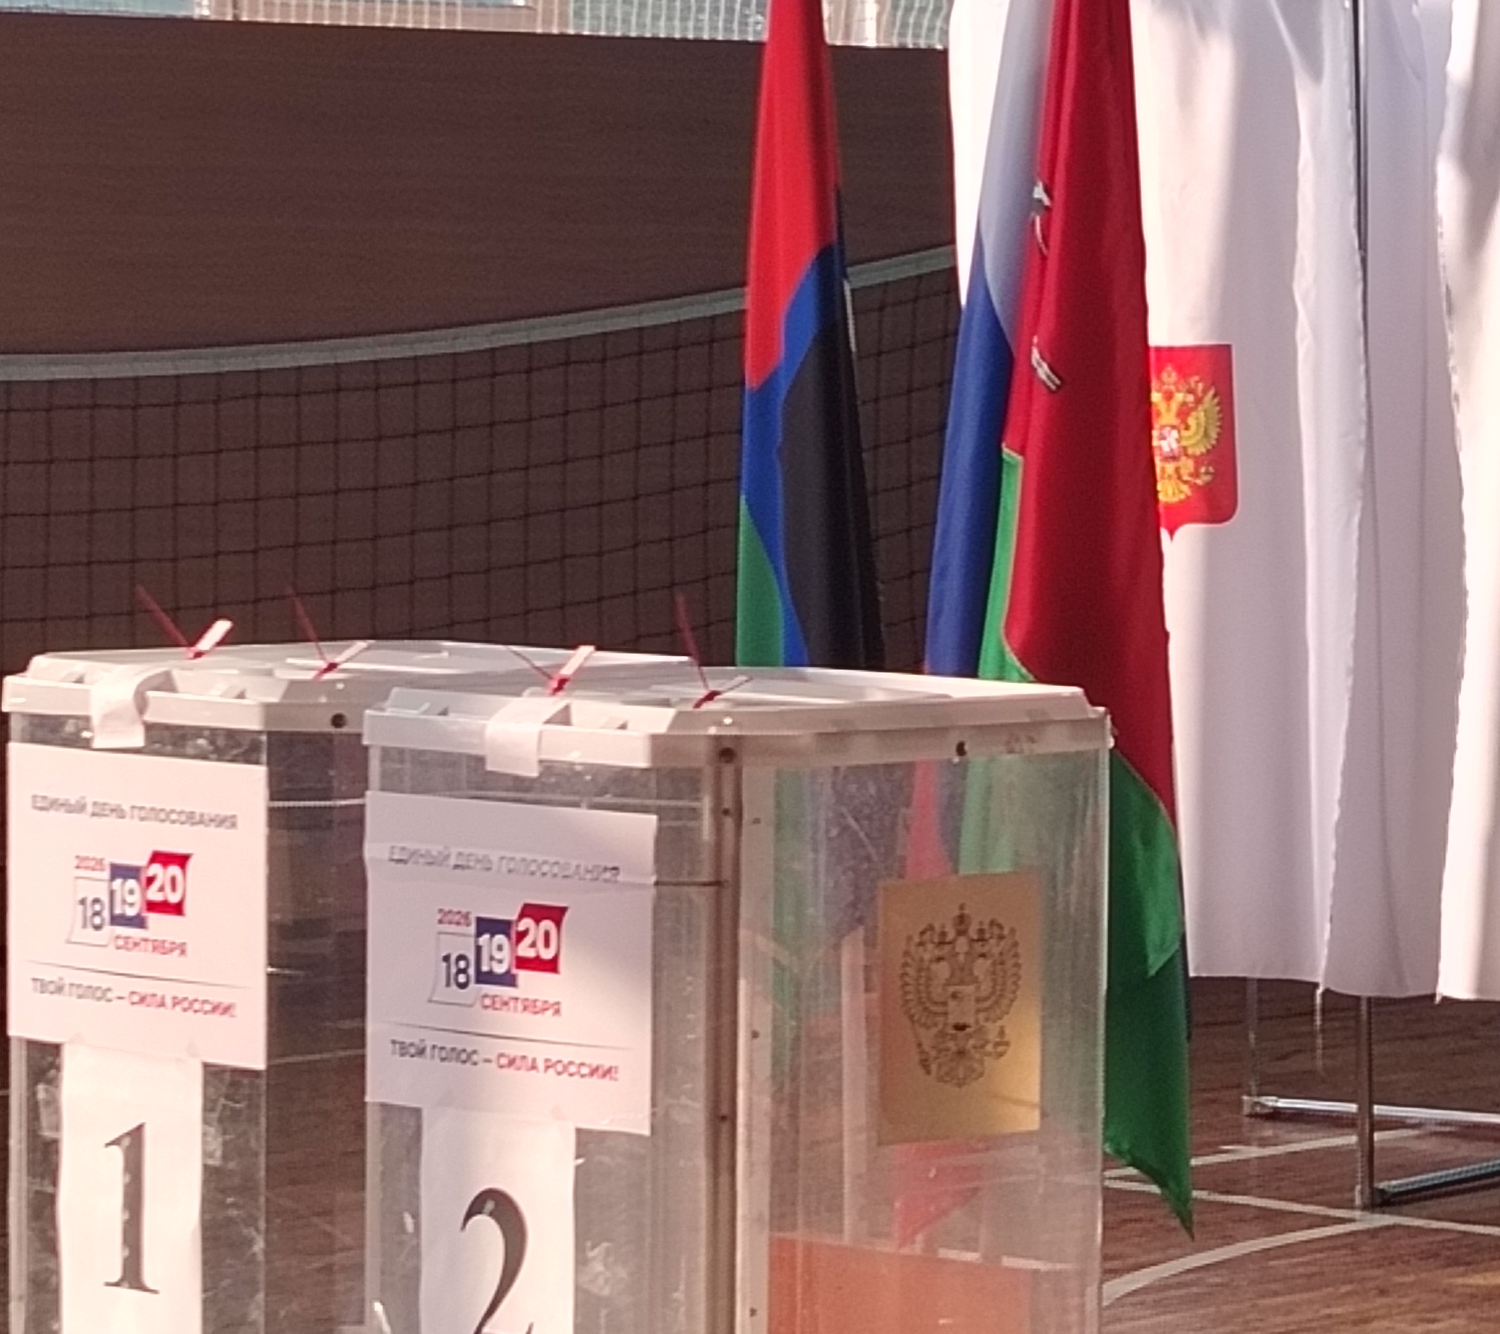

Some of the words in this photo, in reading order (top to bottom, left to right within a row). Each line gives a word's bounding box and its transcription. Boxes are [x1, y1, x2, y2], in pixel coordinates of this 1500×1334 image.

[31, 794, 87, 814] ЕДИНЫЙ
[90, 801, 126, 819] ДЕНЬ
[130, 805, 238, 830] ГОЛОСОВАНИЯ
[388, 845, 450, 866] ЕДИНЫЙ
[452, 852, 492, 871] ДЕНЬ
[500, 856, 620, 883] ГОЛОСОВАНИЯ
[78, 896, 105, 931] 18
[112, 879, 140, 916] 19
[146, 864, 184, 903] 20
[114, 935, 187, 957] СЕНТЯБРЯ
[442, 952, 471, 990] 18
[478, 934, 510, 974] 19
[517, 918, 558, 959] 20
[32, 977, 67, 995] ТВОЙ
[68, 981, 113, 1002] ГОЛОС
[128, 991, 167, 1010] СИЛА
[481, 993, 562, 1017] СЕНТЯБРЯ
[391, 1039, 427, 1058] ТВОЙ
[429, 1043, 479, 1066] ГОЛОС
[497, 1053, 539, 1073] СИЛА
[544, 1058, 619, 1081] РОССИИ!
[104, 1123, 160, 1294] 1
